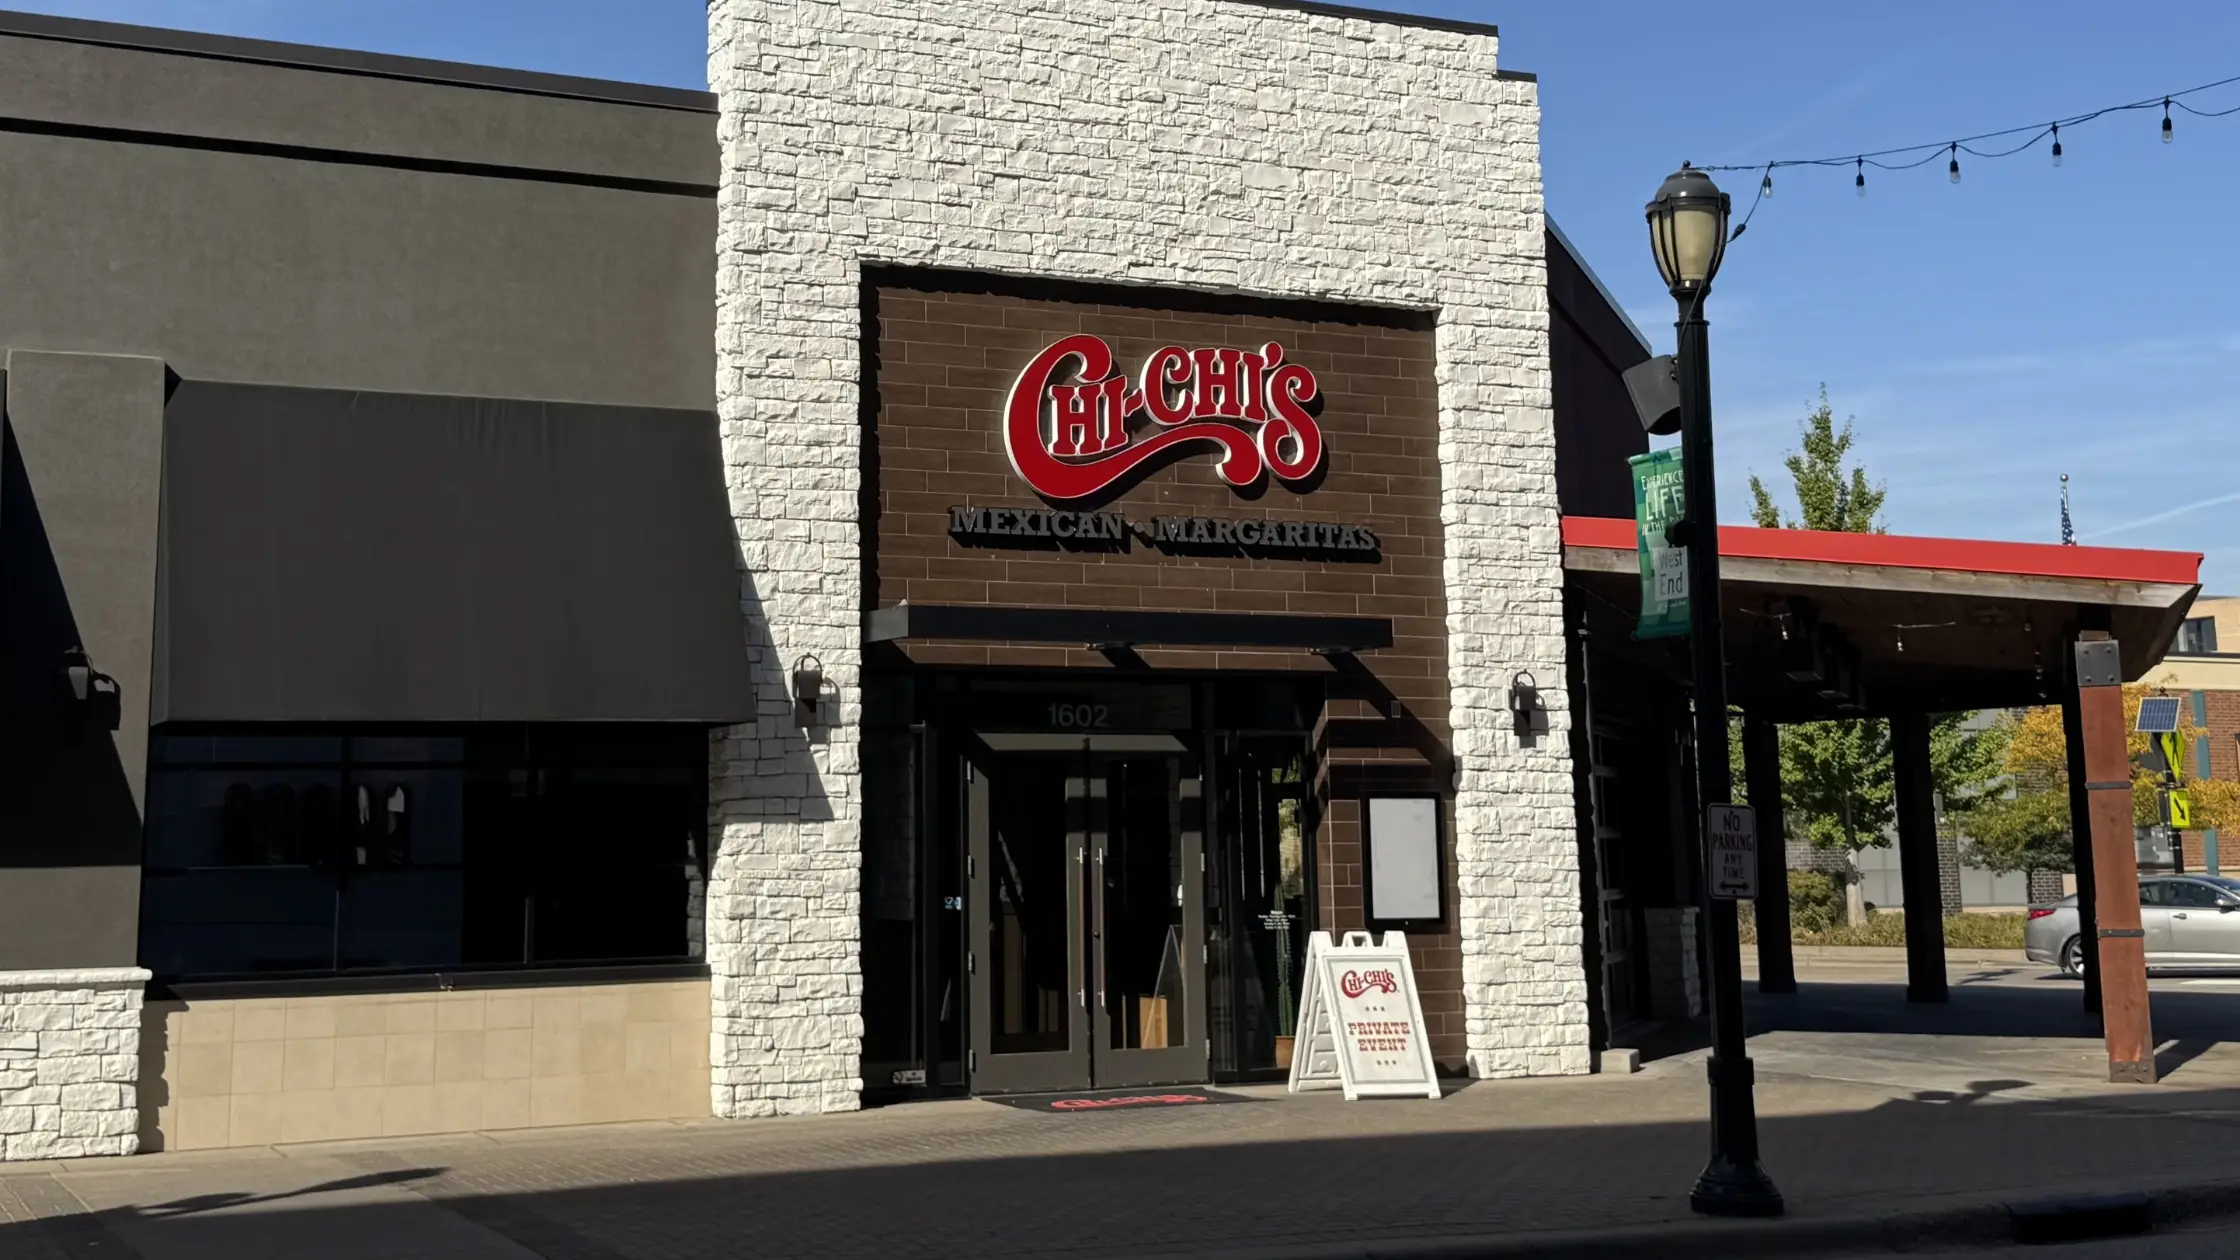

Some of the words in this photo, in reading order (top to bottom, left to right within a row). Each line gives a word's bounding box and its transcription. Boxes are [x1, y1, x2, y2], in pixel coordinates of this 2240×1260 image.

[1645, 486, 1685, 520] LIFE
[950, 505, 1125, 541] MEXICAN
[1154, 515, 1378, 552] MARGARITAS
[1659, 549, 1683, 569] West
[1660, 572, 1683, 596] End
[1047, 702, 1109, 727] 1602
[1723, 814, 1740, 832] NO
[1713, 833, 1753, 851] PARKING
[1725, 853, 1742, 865] ANY
[1724, 866, 1745, 879] TIME
[1347, 1021, 1411, 1035] PRIVATE
[1356, 1038, 1407, 1052] EVENT
